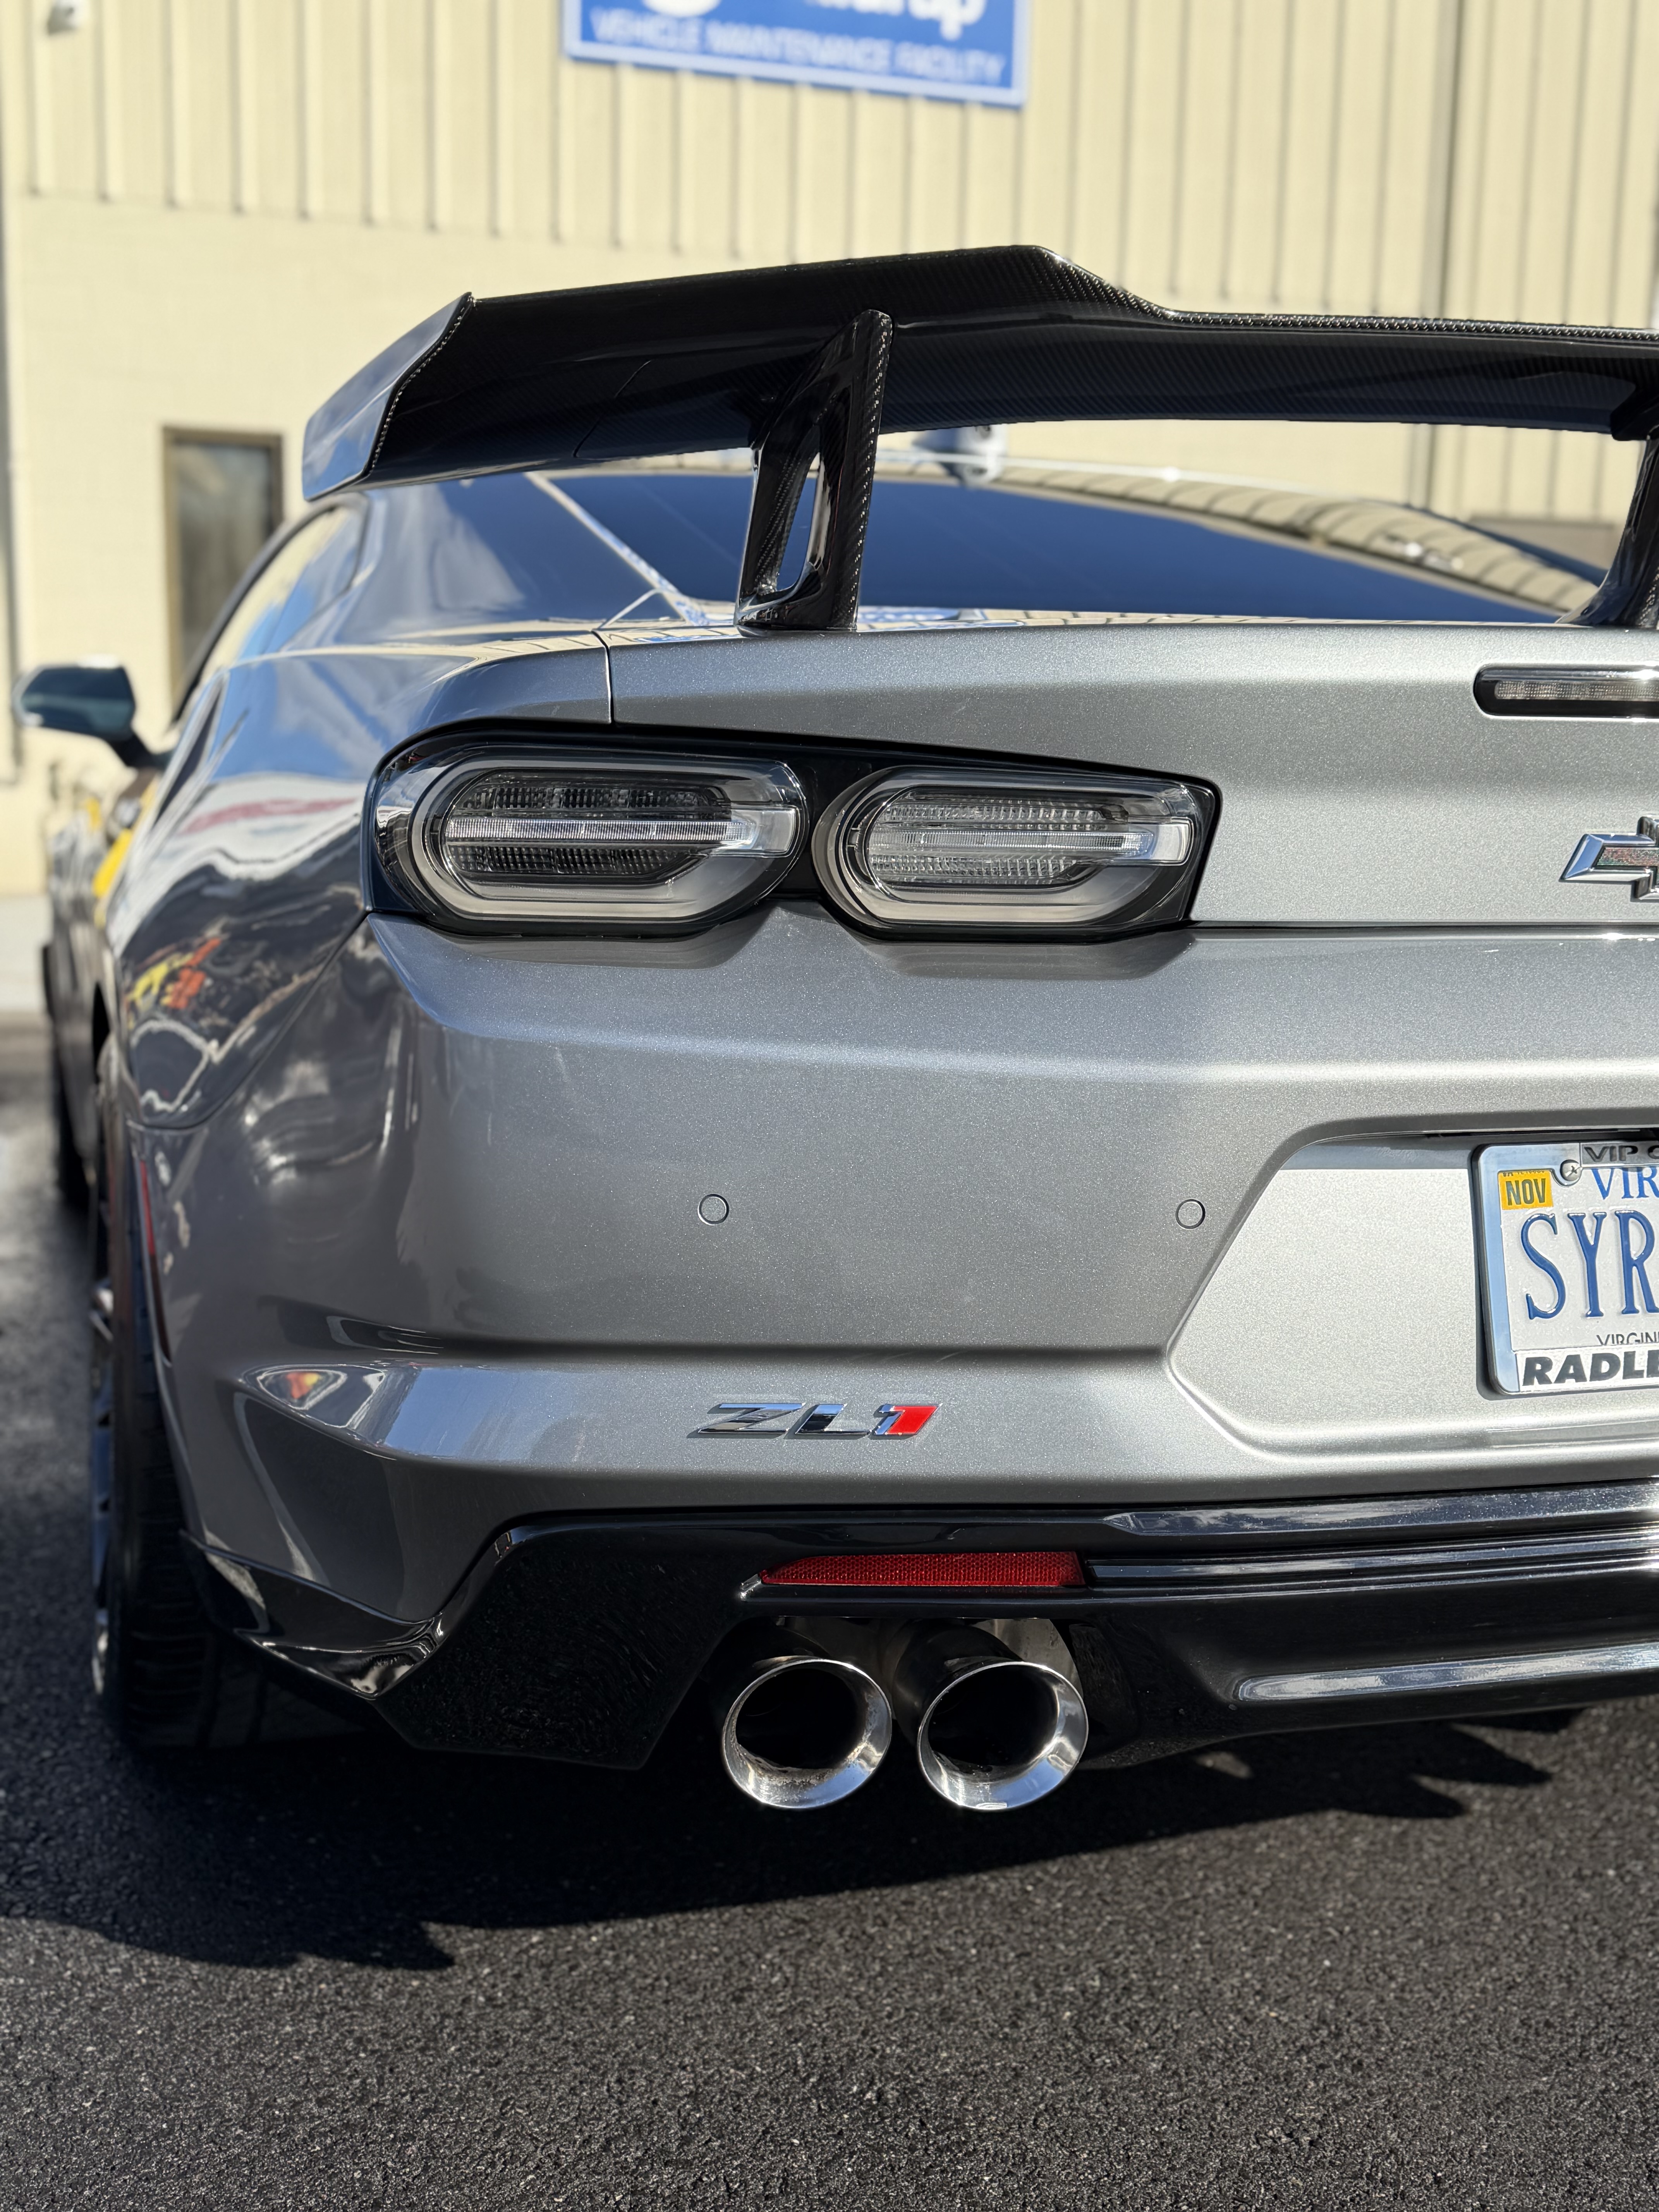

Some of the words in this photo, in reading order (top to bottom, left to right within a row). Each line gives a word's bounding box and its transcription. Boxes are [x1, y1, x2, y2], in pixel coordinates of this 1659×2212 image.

[589, 7, 702, 51] VEHICLE
[705, 20, 893, 74] MAINTENANCE
[1584, 1145, 1638, 1162] VIP
[1506, 1178, 1546, 1206] NOV
[1591, 1166, 1659, 1200] VIR
[1521, 1209, 1659, 1320] SYR
[697, 1402, 943, 1435] ZL1
